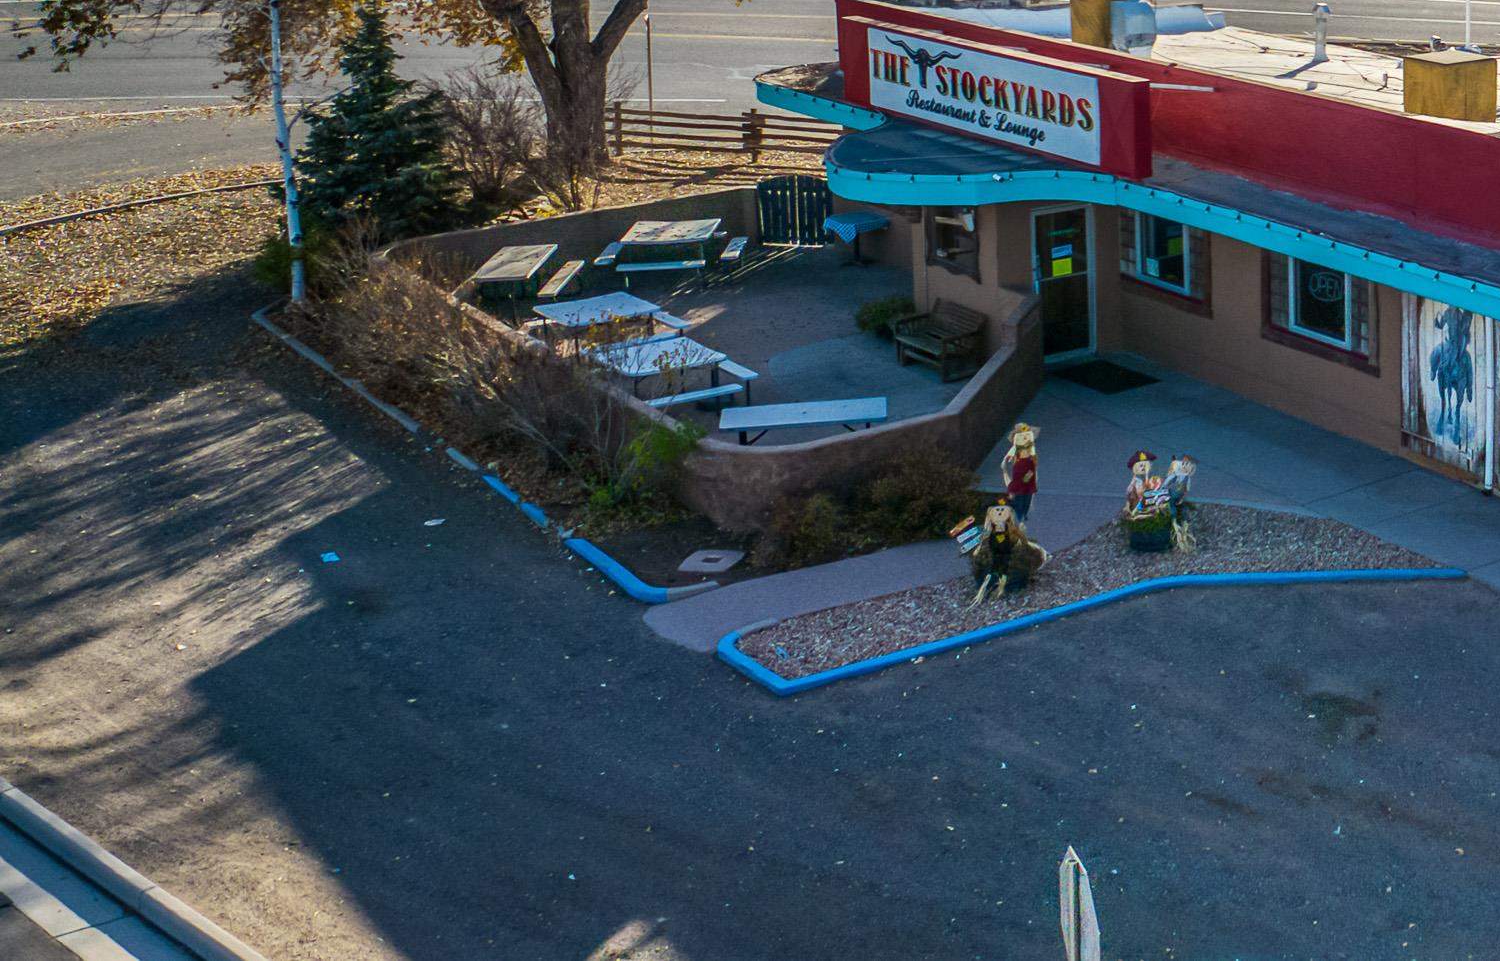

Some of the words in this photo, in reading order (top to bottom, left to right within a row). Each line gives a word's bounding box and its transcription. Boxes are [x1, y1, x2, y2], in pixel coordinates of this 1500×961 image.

[870, 48, 911, 87] THE
[935, 65, 1094, 132] STOCKYARDS
[905, 89, 977, 123] Restaurant
[978, 109, 991, 128] &
[993, 112, 1046, 146] Lounge
[1311, 273, 1343, 299] OPEN
